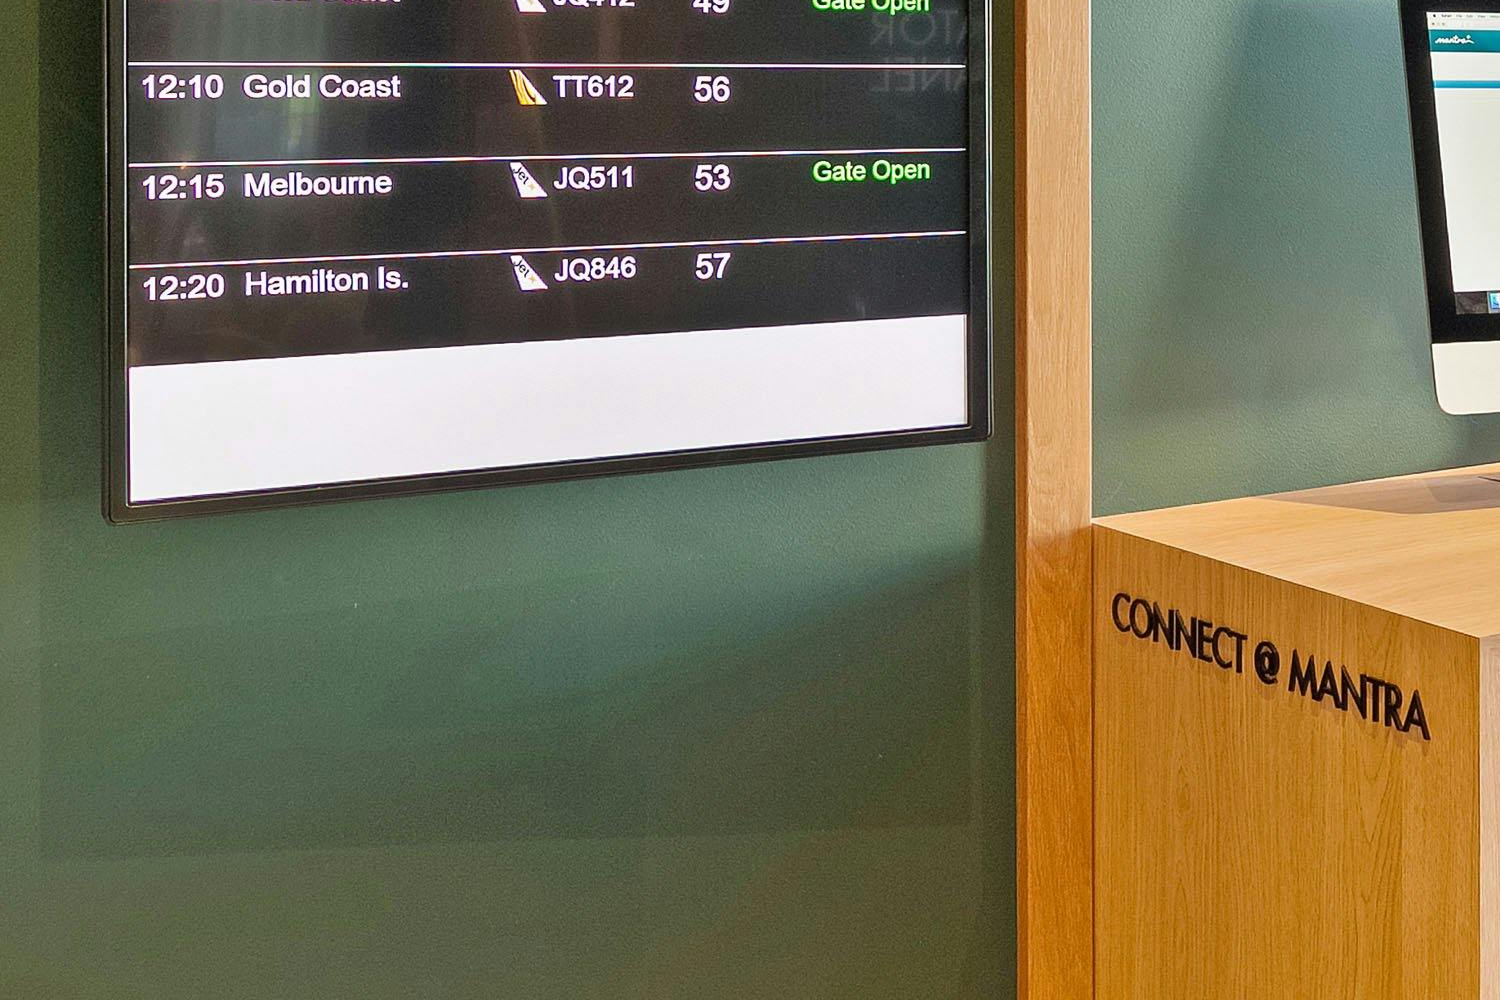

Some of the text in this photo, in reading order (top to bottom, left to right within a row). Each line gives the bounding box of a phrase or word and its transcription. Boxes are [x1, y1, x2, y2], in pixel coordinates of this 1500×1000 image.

[143, 75, 223, 98] 12:10
[244, 75, 400, 98] Gold Coast
[553, 75, 633, 97] TT612
[695, 76, 730, 101] 56
[245, 172, 392, 197] Melbourne
[554, 166, 632, 190] JQ511
[695, 164, 730, 190] 53
[813, 160, 929, 184] Gate Open
[143, 174, 224, 199] 12:15
[555, 256, 636, 281] JQ846
[696, 253, 730, 279] 57
[144, 274, 224, 300] 12:20
[246, 267, 408, 296] Hamilton Is.
[1112, 592, 1431, 740] CONNECT @ MANTRA
